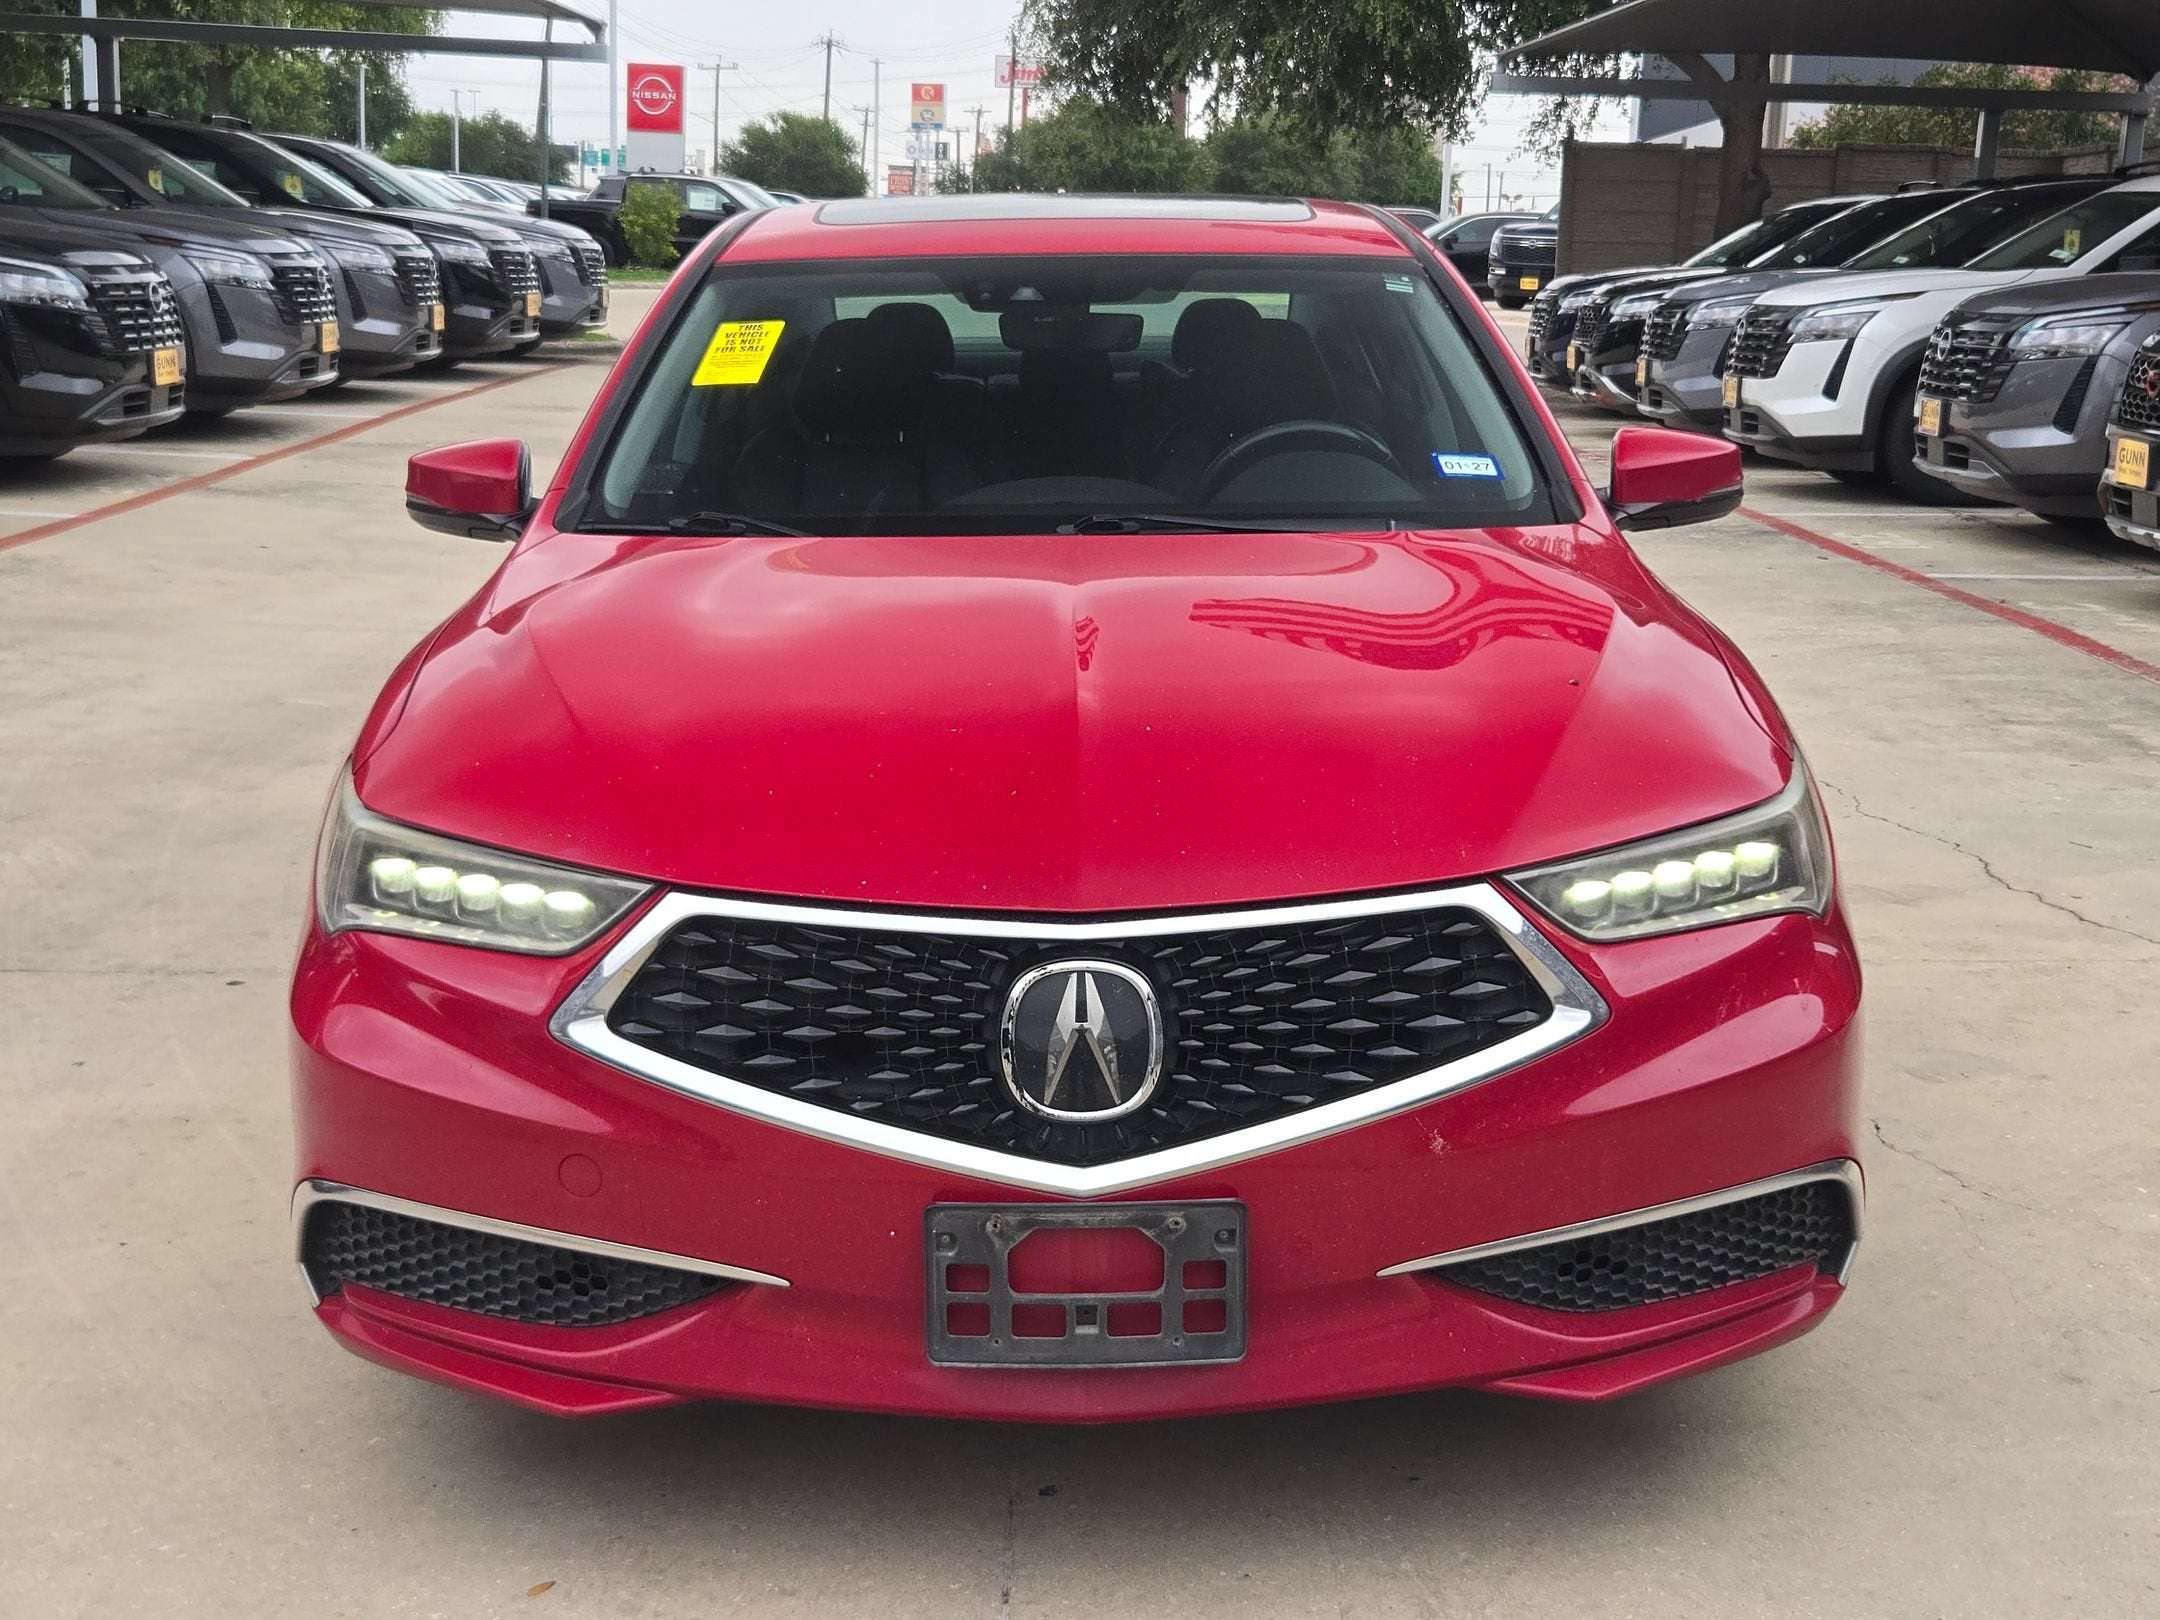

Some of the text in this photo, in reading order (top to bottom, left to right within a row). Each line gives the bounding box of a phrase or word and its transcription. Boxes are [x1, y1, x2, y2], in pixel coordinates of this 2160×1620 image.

[632, 91, 676, 101] NISSAN
[738, 324, 765, 332] THIS
[725, 331, 770, 339] VEHICLE
[725, 338, 762, 346] IS NOT
[714, 345, 766, 354] FOR SALE
[157, 355, 176, 369] GUNN
[2119, 447, 2146, 467] GUNN
